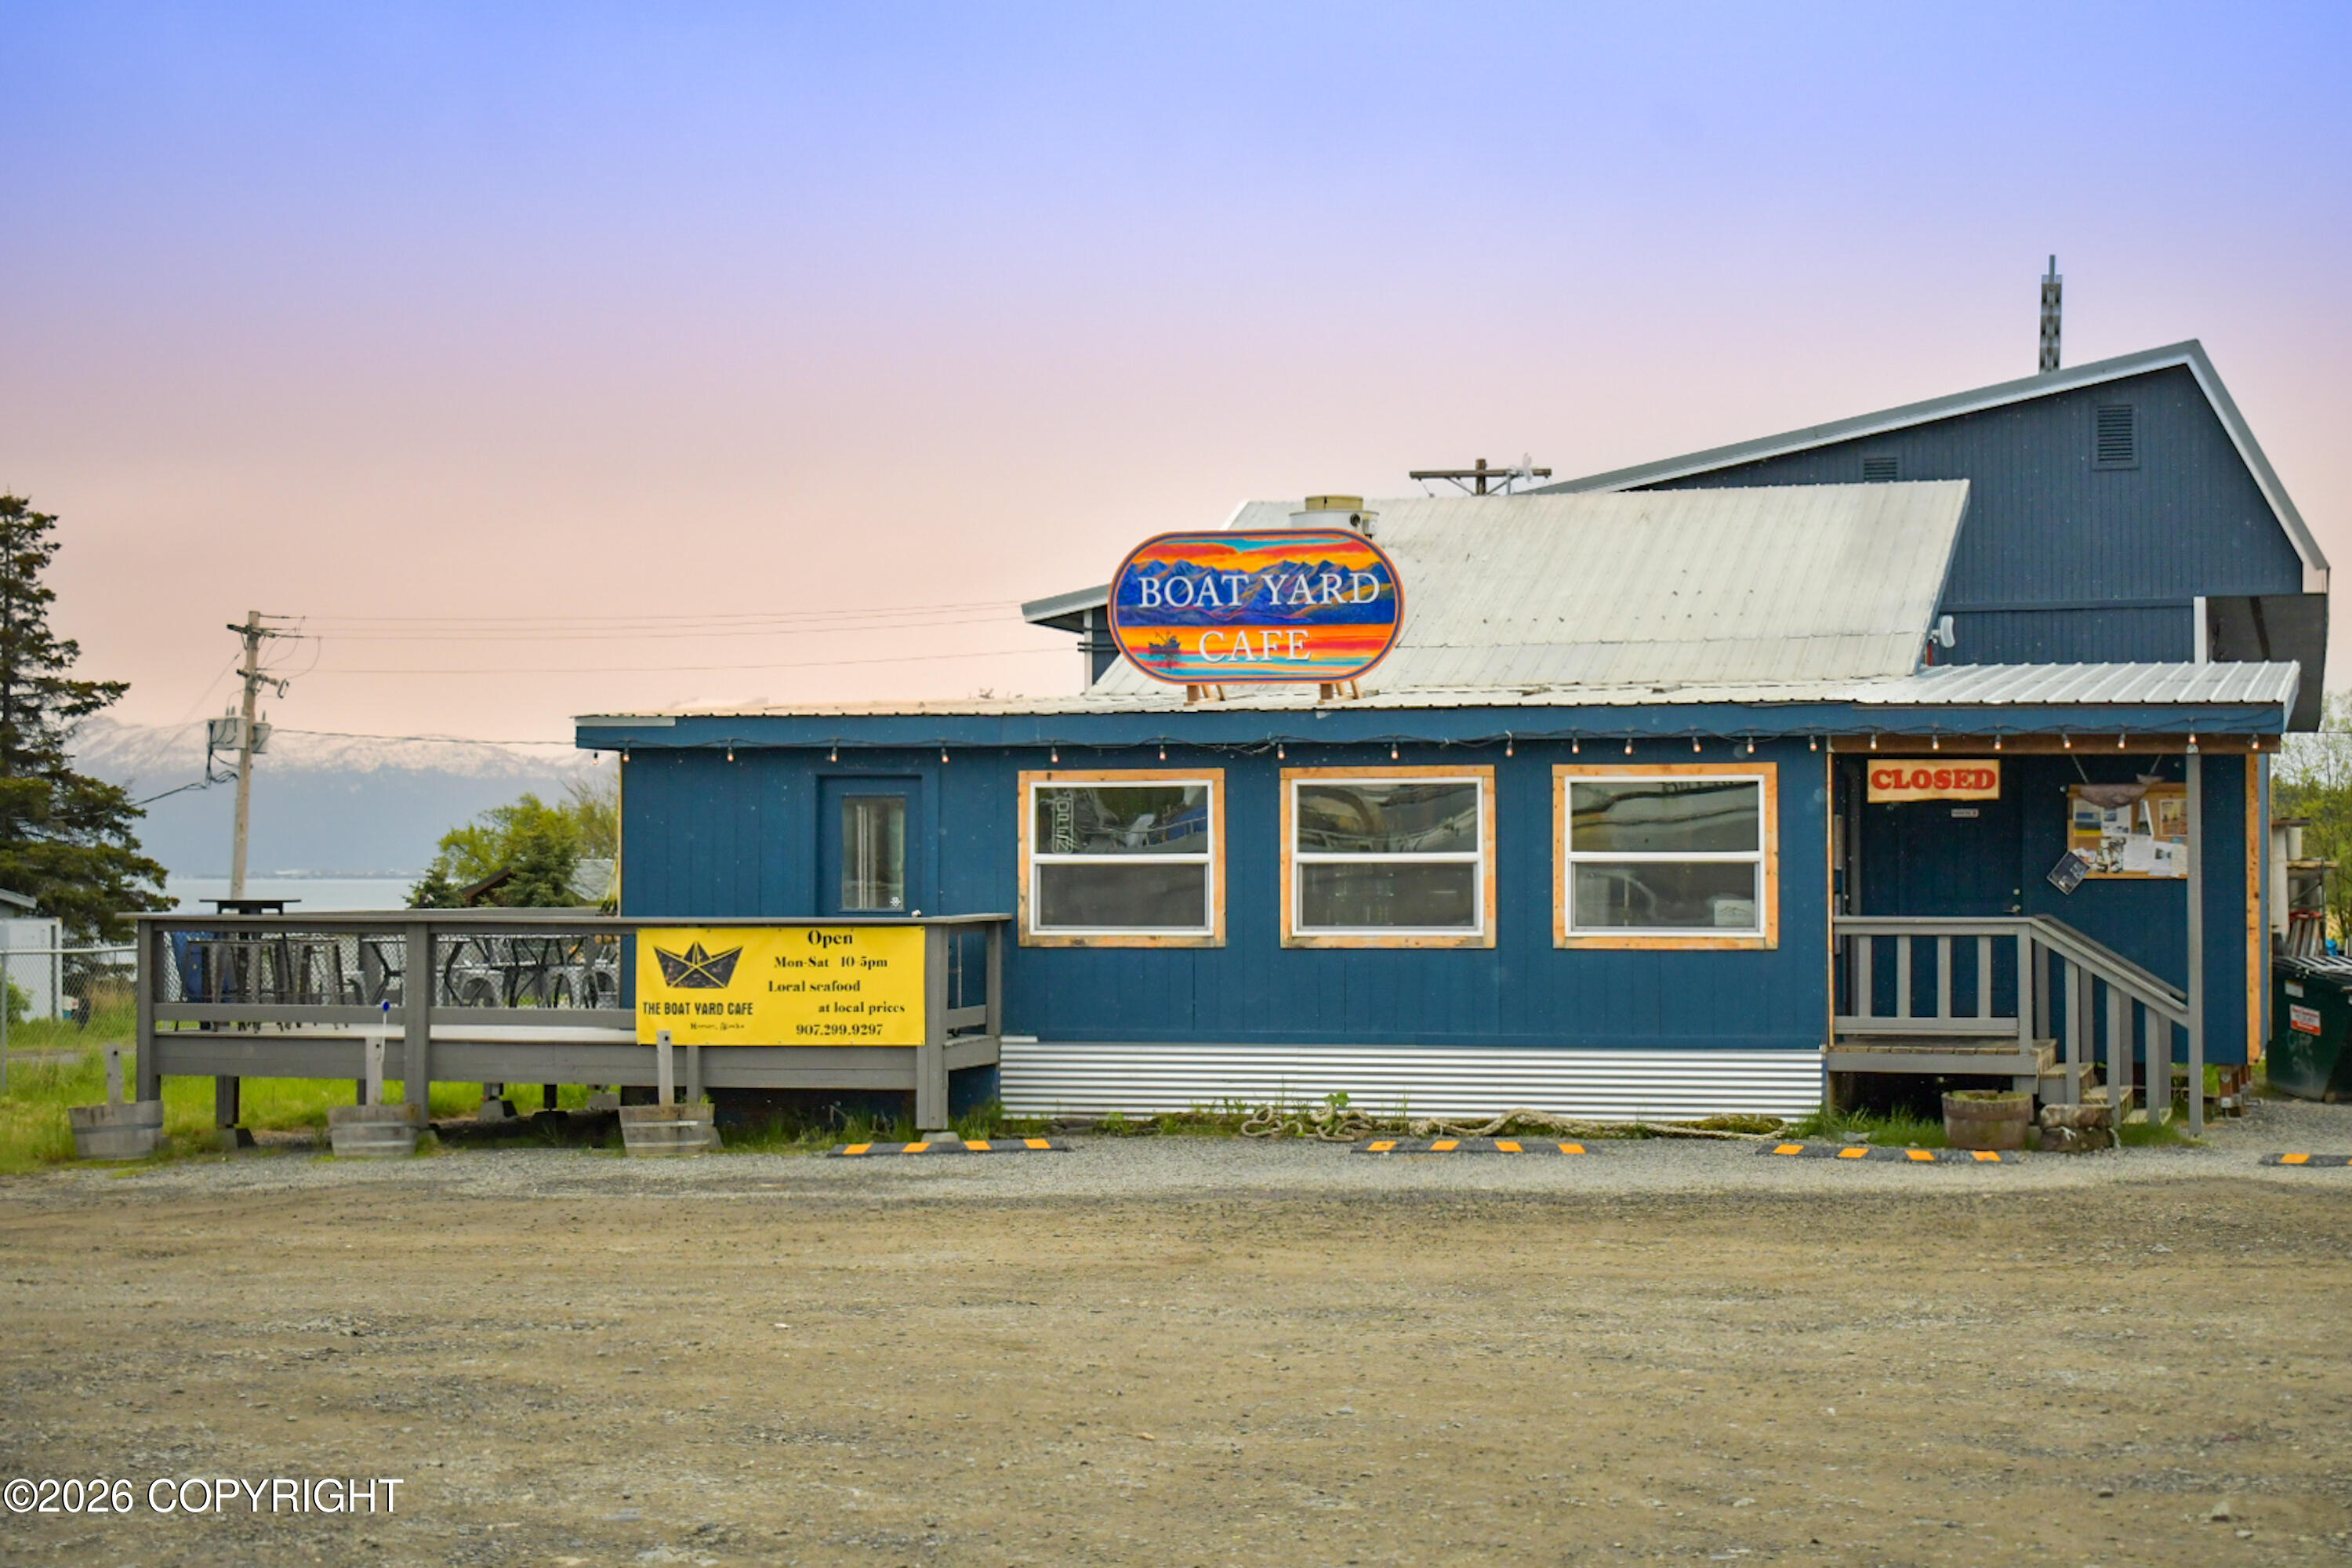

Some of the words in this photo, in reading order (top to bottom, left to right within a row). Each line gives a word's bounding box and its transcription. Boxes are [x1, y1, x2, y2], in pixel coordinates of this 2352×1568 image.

[1138, 575, 1248, 608] BOAT
[1261, 572, 1381, 605] YARD
[1198, 629, 1312, 663] CAFE
[1871, 768, 1997, 790] CLOSED
[808, 930, 854, 949] Open
[774, 956, 829, 968] Mon-Sat
[768, 981, 806, 993] Local
[810, 981, 861, 993] seafood
[643, 1002, 661, 1015] THE
[664, 1002, 691, 1015] BOAT
[695, 1002, 724, 1015] YARD
[727, 1002, 753, 1015] CAFE
[818, 1003, 830, 1013] at
[834, 1002, 864, 1013] local
[869, 1001, 906, 1015] prices
[796, 1024, 884, 1036] 907.299.9297
